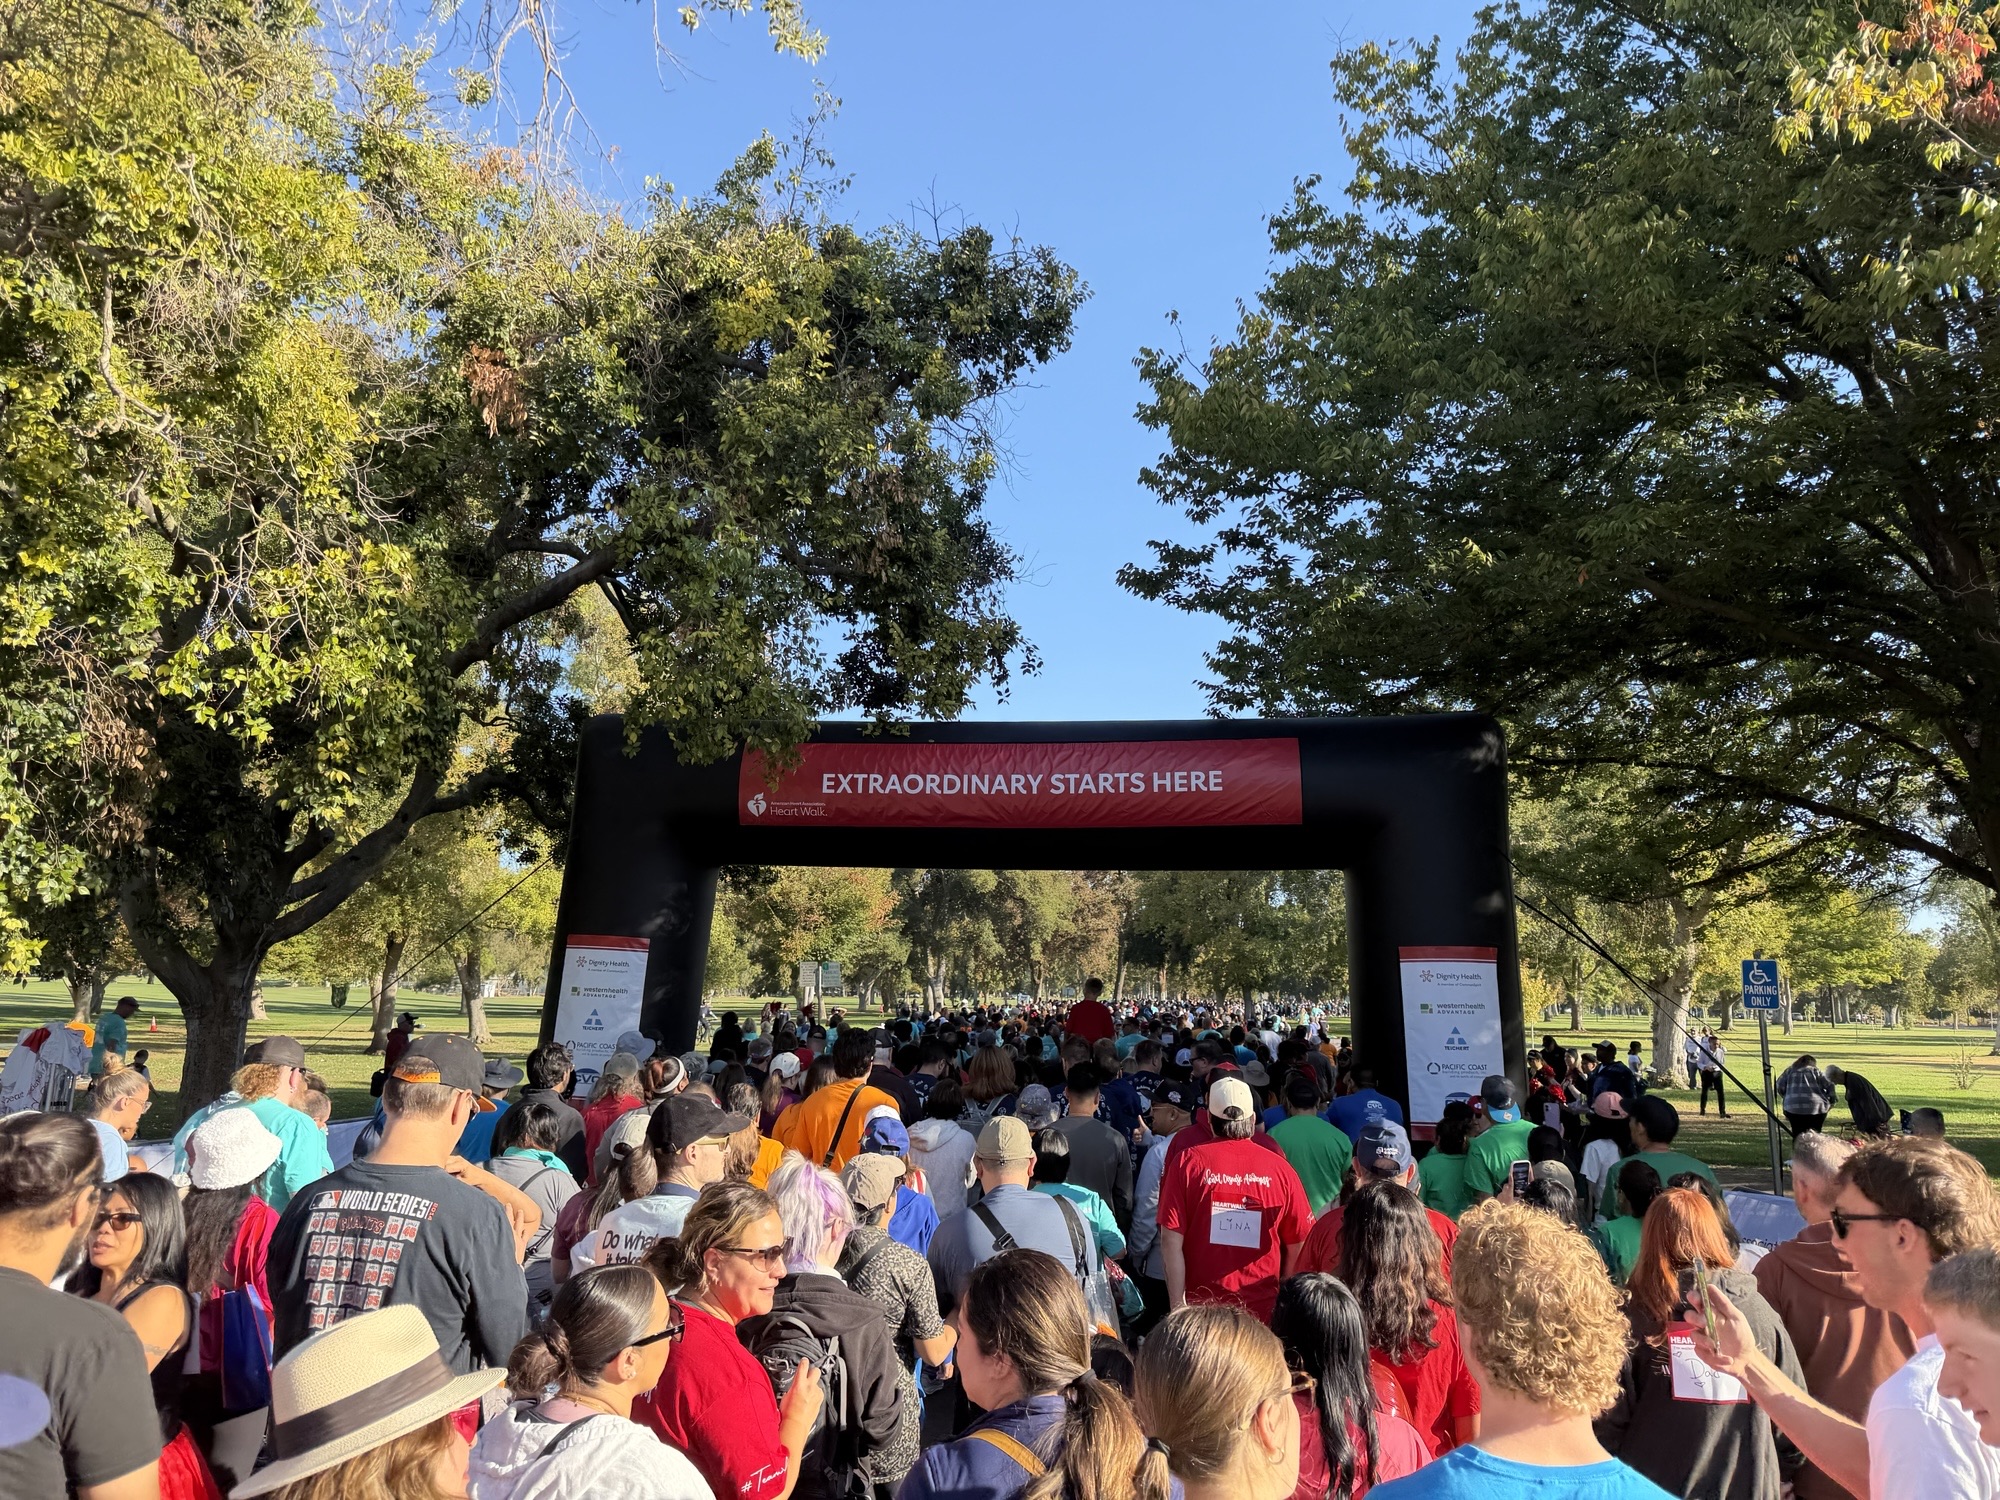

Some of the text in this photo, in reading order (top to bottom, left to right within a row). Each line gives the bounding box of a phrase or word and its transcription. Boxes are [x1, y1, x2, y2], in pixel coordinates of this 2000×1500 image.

[822, 770, 1223, 795] EXTRAORDINARY STARTS HERE
[770, 806, 798, 816] Heart
[589, 959, 609, 967] Dignity
[1436, 973, 1460, 981] Dignity
[1744, 985, 1777, 995] PARKING
[1751, 996, 1771, 1006] ONLY
[338, 1190, 382, 1212] WORLD
[382, 1192, 429, 1219] SERIES
[340, 1215, 385, 1234] GIANTS
[602, 1230, 659, 1250] Do what
[615, 1252, 641, 1265] take
[1670, 1336, 1696, 1345] HEAR
